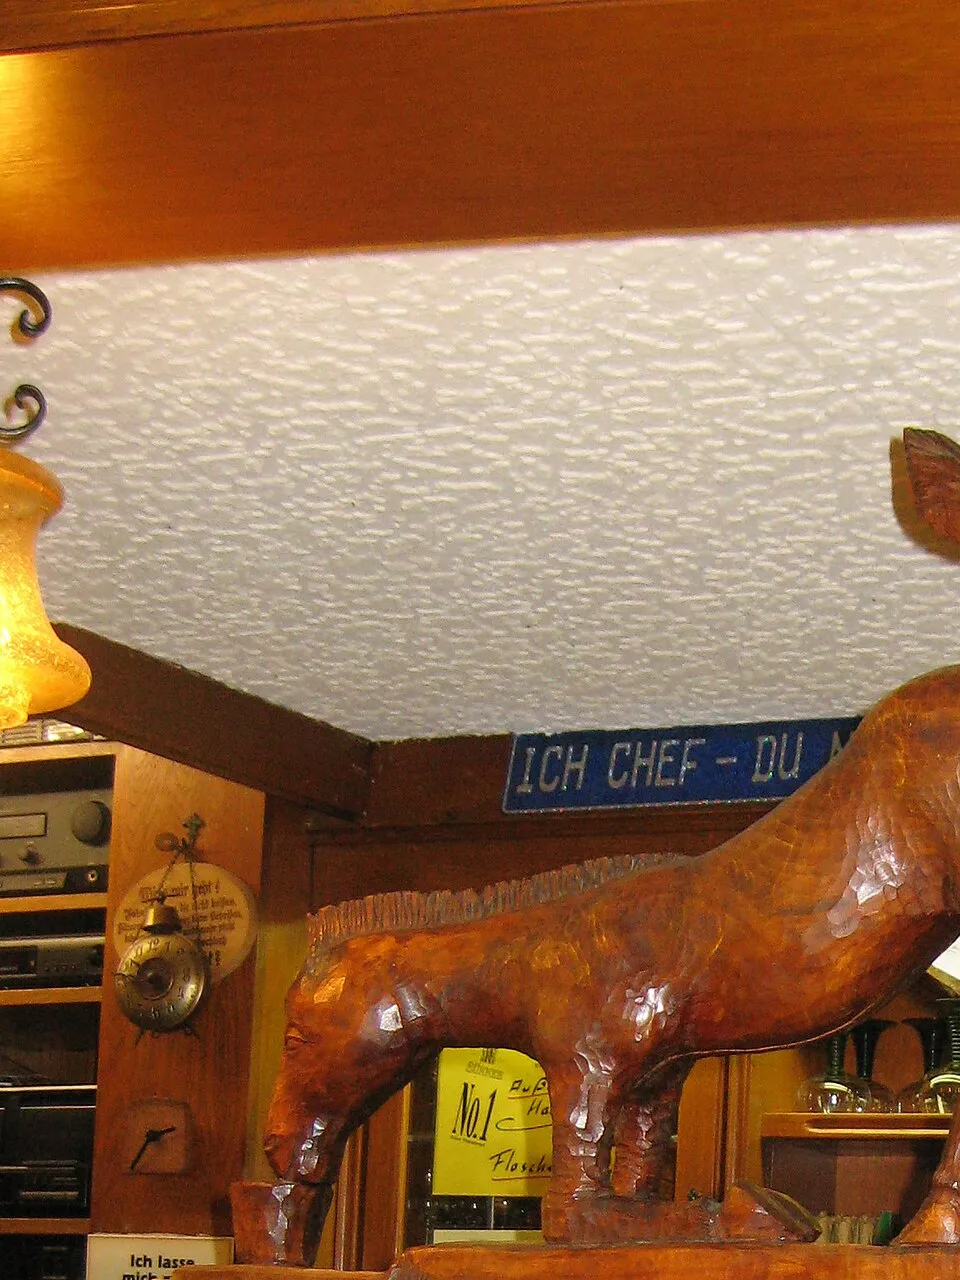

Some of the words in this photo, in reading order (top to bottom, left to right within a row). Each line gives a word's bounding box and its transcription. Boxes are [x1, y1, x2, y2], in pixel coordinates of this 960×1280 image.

[516, 744, 589, 793] ICH
[607, 738, 706, 789] CHEF
[751, 732, 804, 783] DU
[527, 1098, 552, 1116] Ha
[130, 1254, 153, 1268] Ich
